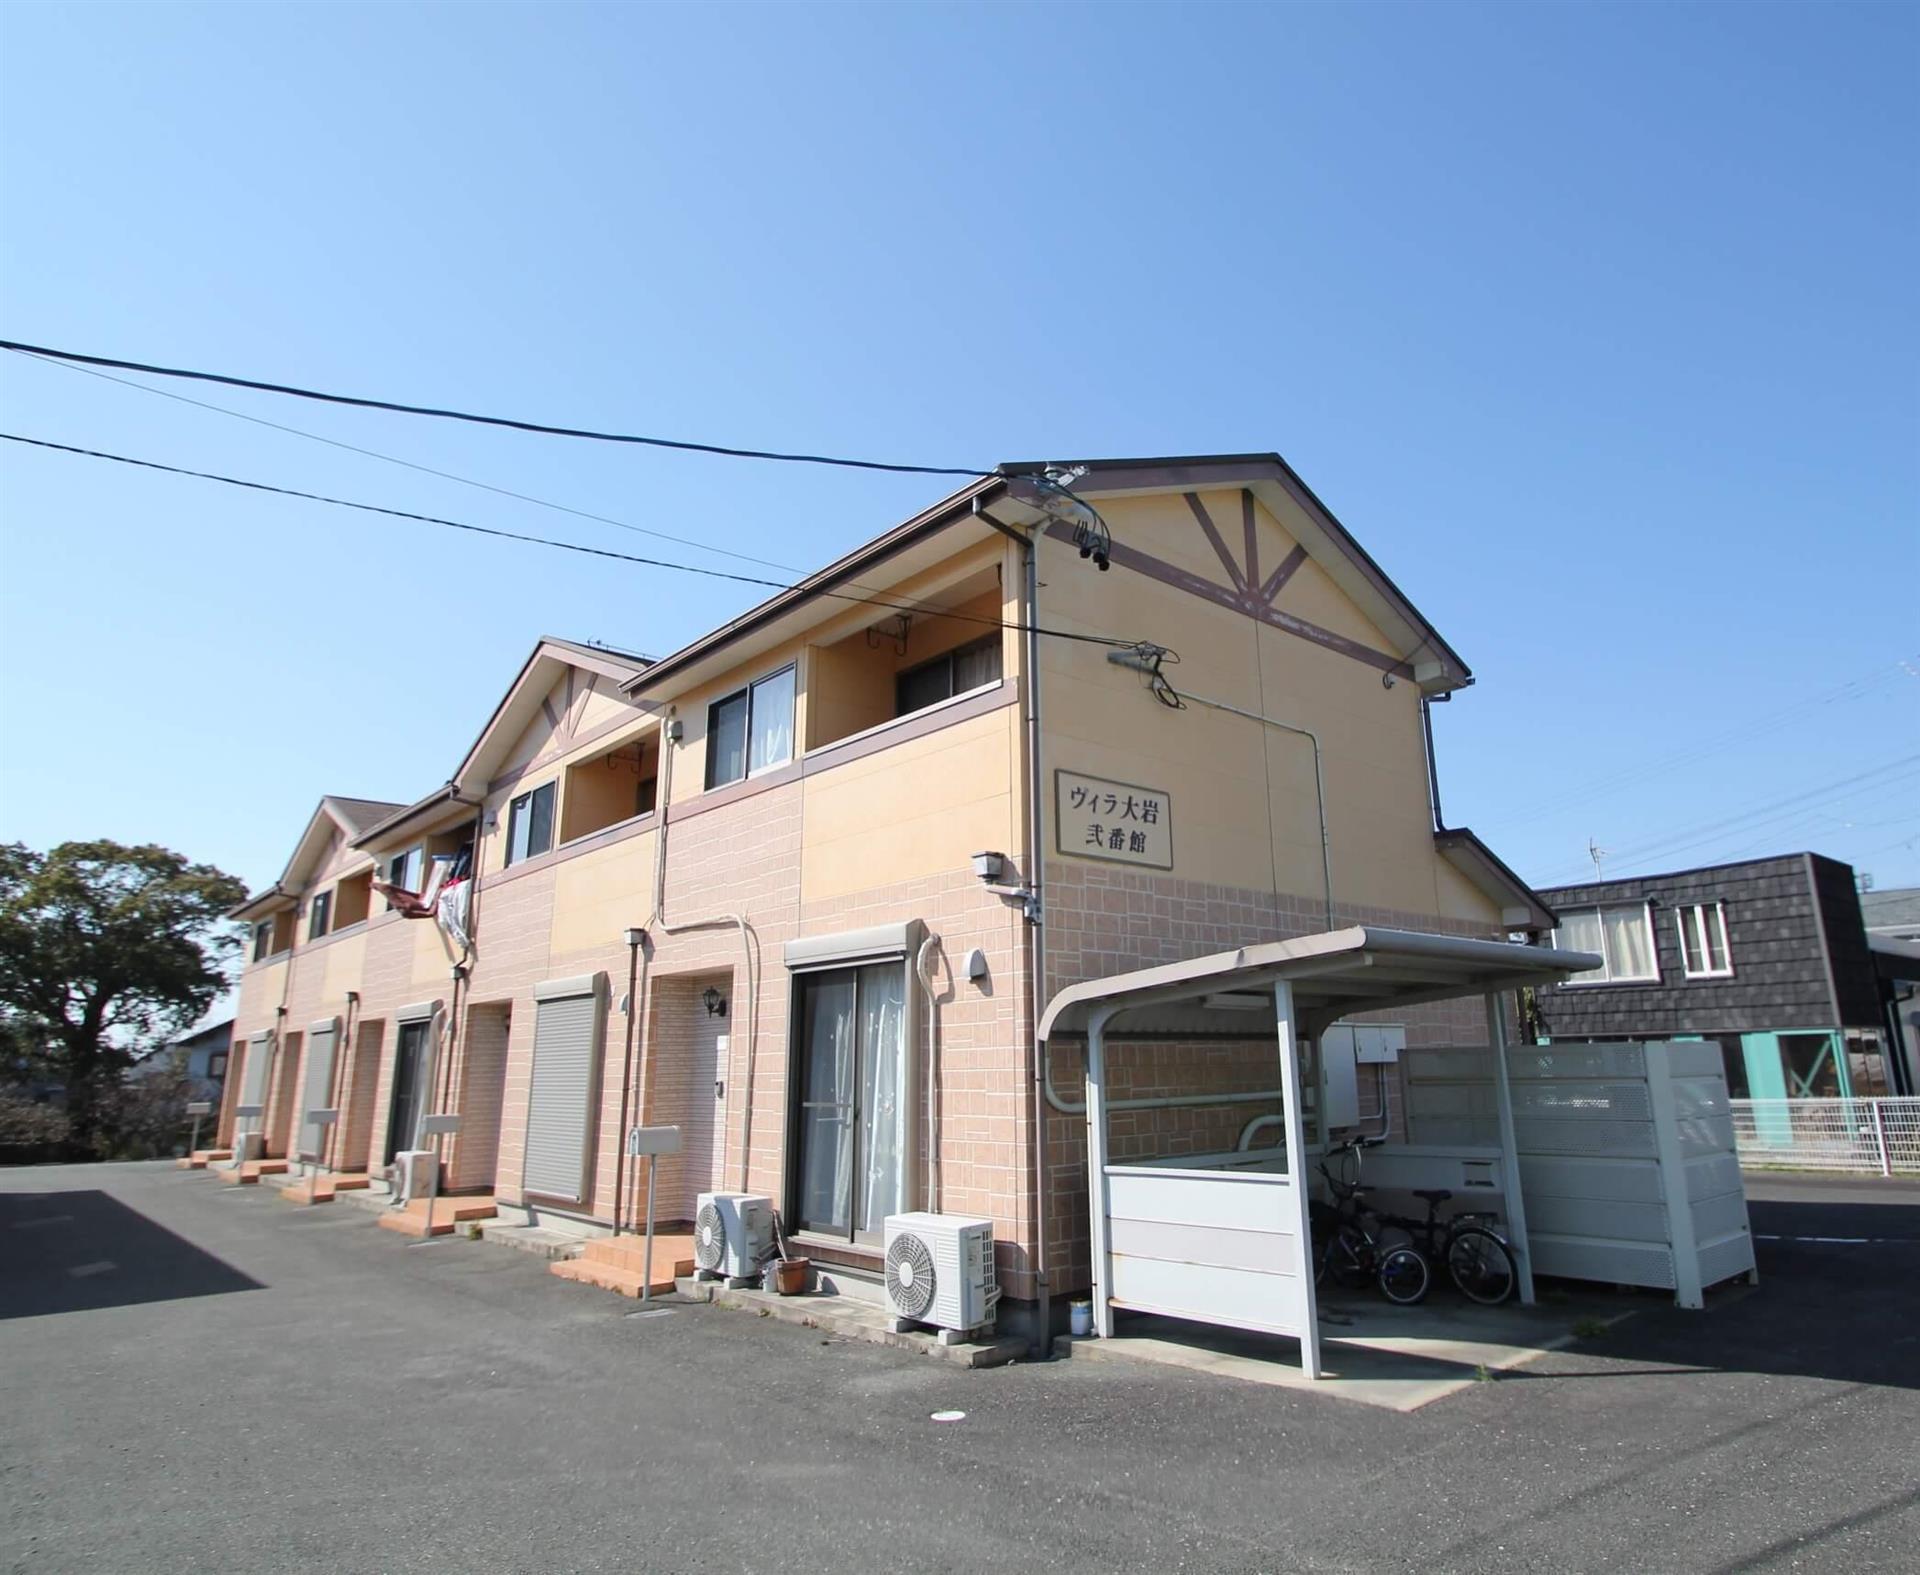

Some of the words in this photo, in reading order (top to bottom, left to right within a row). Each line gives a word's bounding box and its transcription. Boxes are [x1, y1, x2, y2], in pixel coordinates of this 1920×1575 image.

[1071, 787, 1158, 824] ヴィラ大岩
[1086, 824, 1146, 853] 弐番館
